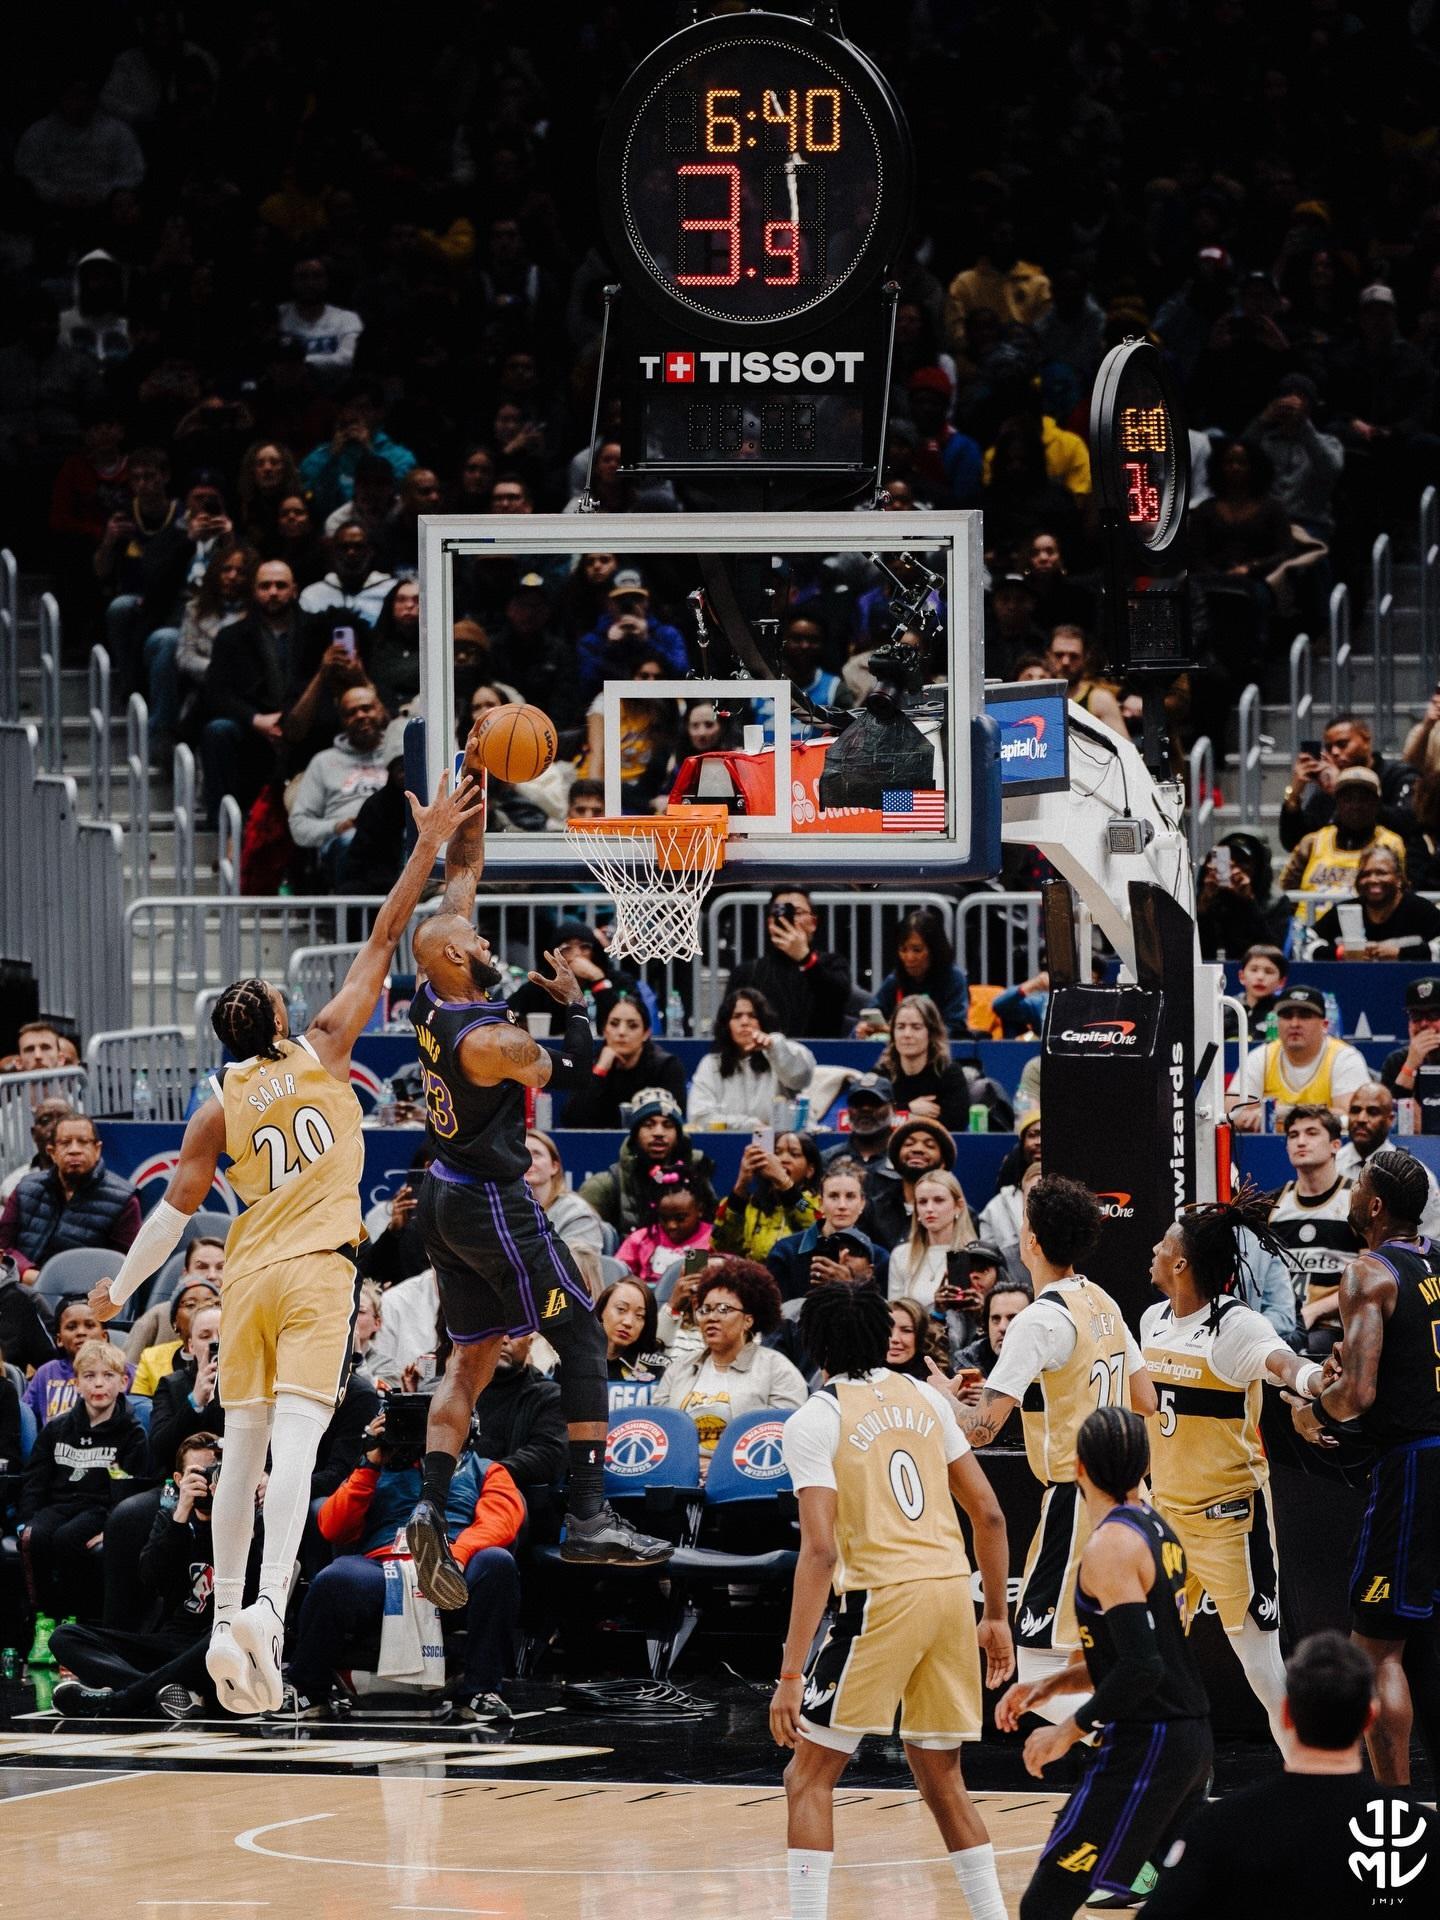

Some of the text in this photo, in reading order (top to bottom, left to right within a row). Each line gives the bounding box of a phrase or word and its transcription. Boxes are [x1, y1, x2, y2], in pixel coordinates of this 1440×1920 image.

[705, 89, 841, 153] 6:40
[676, 165, 799, 286] 3.9
[700, 351, 864, 383] TISSOT
[248, 1073, 296, 1112] SARR
[252, 1105, 336, 1193] 20
[1169, 1041, 1185, 1207] wizards
[848, 1406, 936, 1451] COULIBALY
[1158, 1389, 1179, 1438] 5
[888, 1449, 925, 1522] 0
[426, 1786, 697, 1804] CITY
